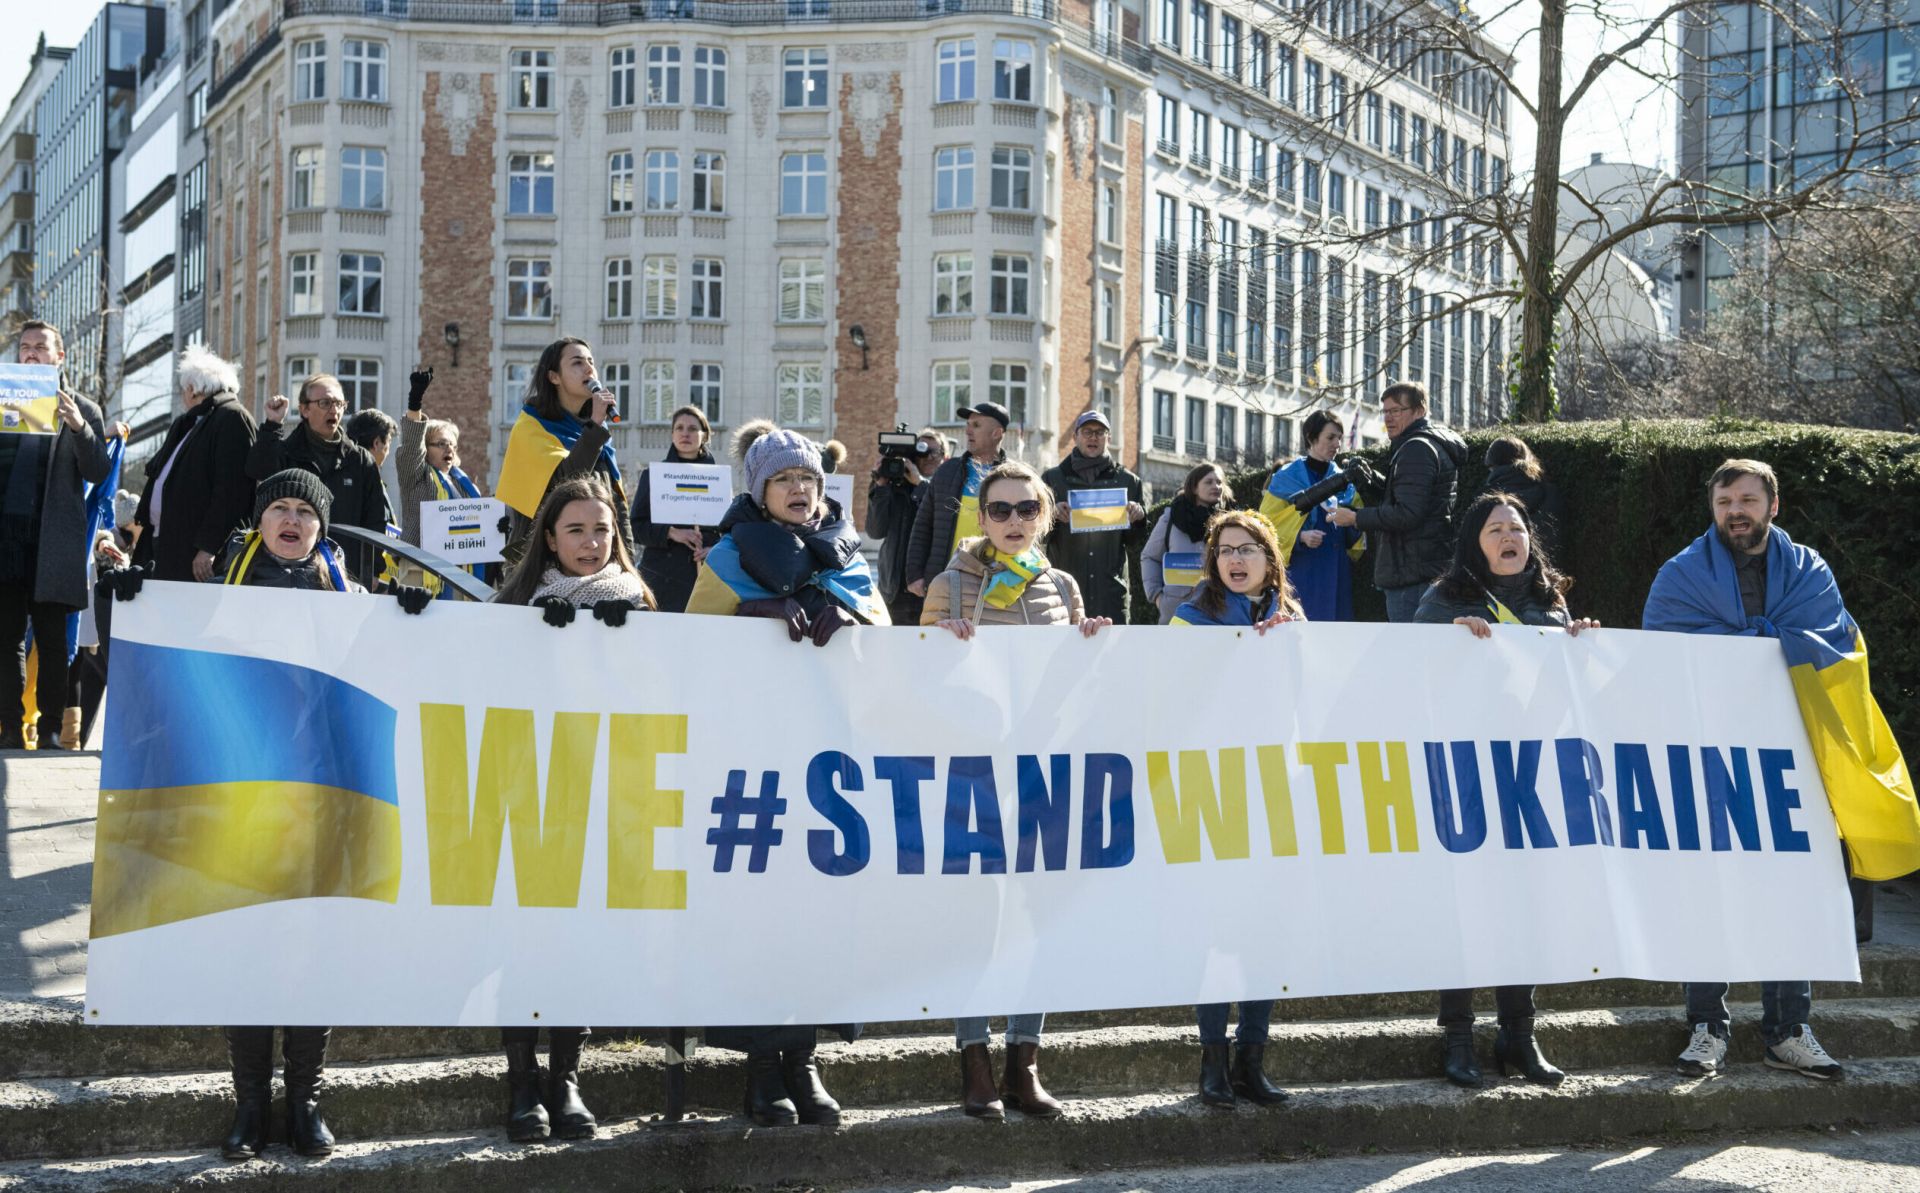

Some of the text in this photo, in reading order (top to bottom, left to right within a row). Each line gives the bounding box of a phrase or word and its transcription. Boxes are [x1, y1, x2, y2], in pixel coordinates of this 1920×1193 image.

[13, 388, 39, 398] YOUR
[0, 397, 33, 407] PPORT
[663, 473, 720, 481] #StandWithUkraine
[661, 493, 724, 503] #Together4Freedom
[458, 503, 482, 511] Oorlog
[458, 536, 486, 550] війні
[420, 703, 1811, 910] WE #STANDWITHUKRAINE
